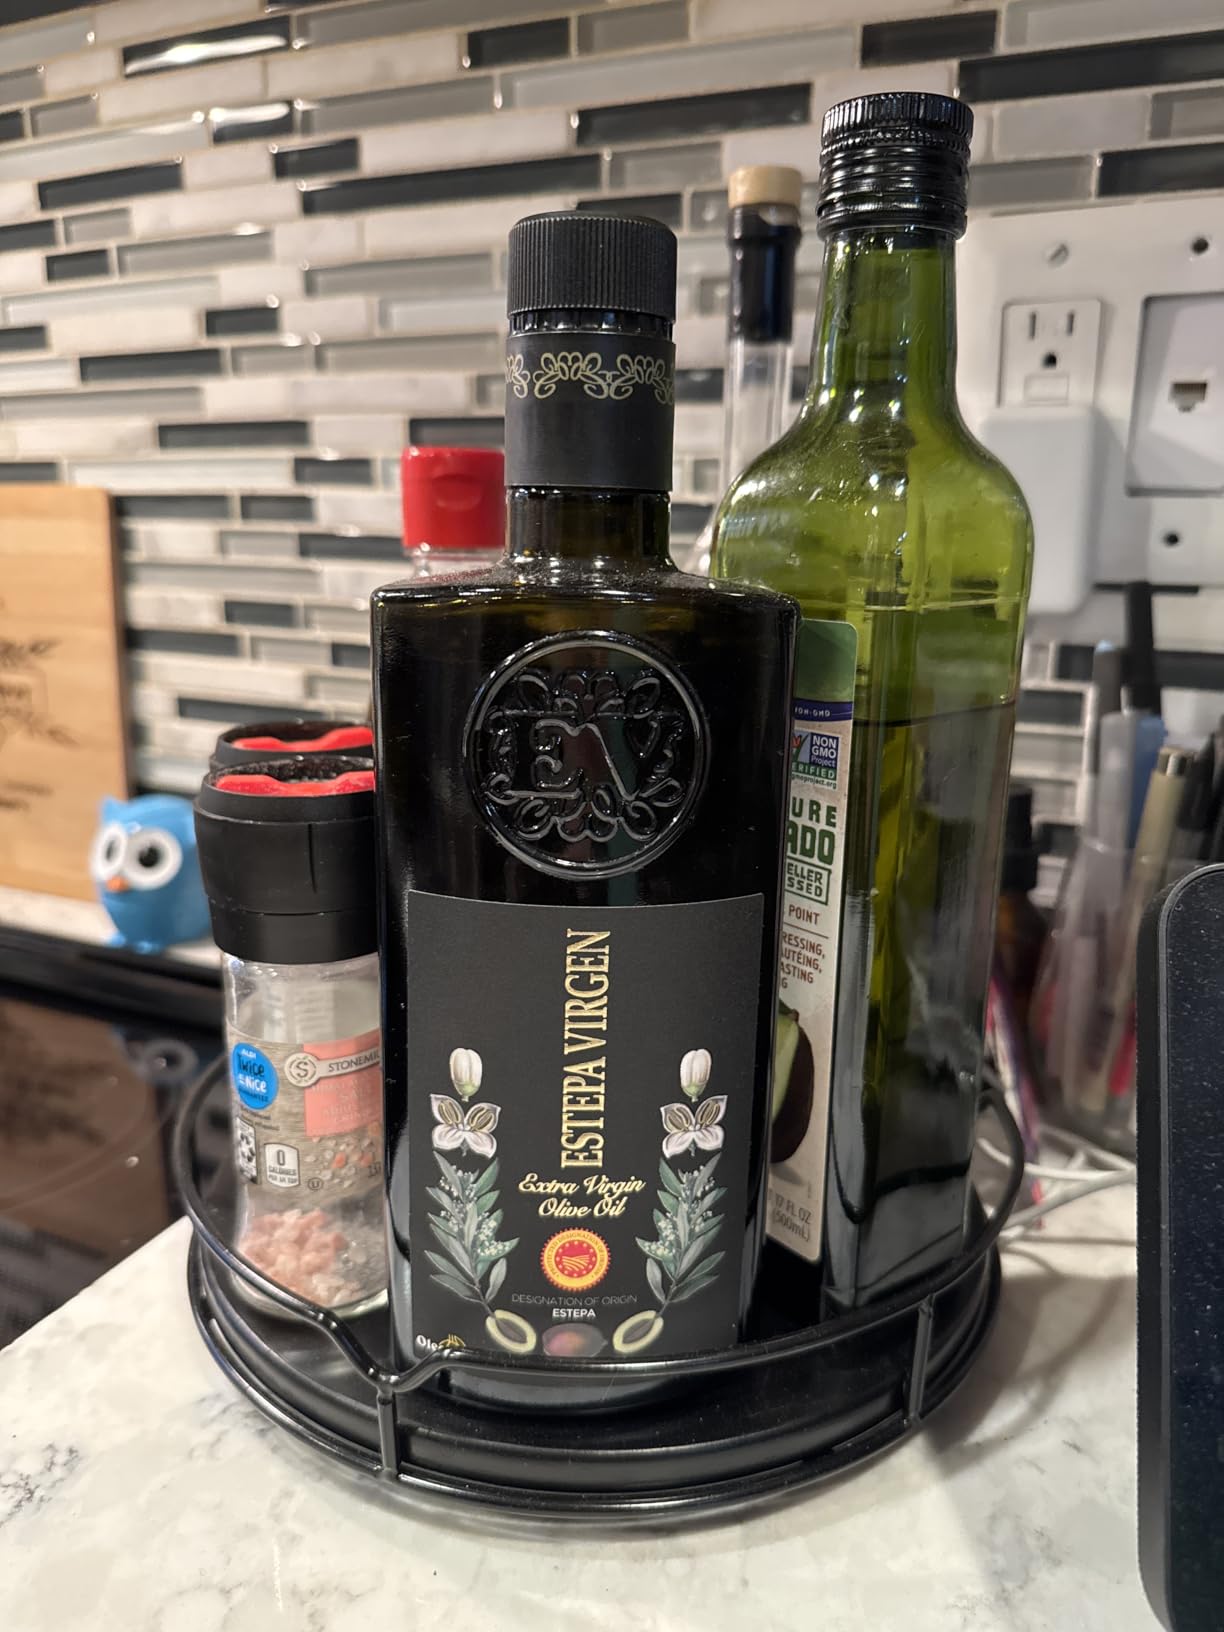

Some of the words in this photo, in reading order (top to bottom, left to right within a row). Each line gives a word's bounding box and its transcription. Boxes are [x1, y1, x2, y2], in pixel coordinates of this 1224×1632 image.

[812, 735, 837, 749] NON
[811, 746, 837, 759] GMO
[811, 756, 836, 768] Project
[792, 796, 837, 828] URE
[787, 863, 823, 885] ELLER
[787, 878, 823, 897] SSED
[788, 904, 820, 925] POINT
[563, 928, 611, 1055] VIRGEN
[245, 1075, 268, 1094] Nice
[561, 1056, 606, 1168] ESTEPA
[277, 1150, 285, 1166] 0
[518, 1173, 579, 1194] Extra
[583, 1174, 646, 1199] Virgin
[538, 1197, 591, 1217] Olive
[593, 1196, 628, 1217] Oil
[512, 1293, 583, 1306] DESIGNATION
[584, 1296, 599, 1305] OF
[601, 1294, 637, 1305] ORIGIN
[552, 1308, 596, 1318] ESTEPA
[416, 1334, 438, 1351] Ole
